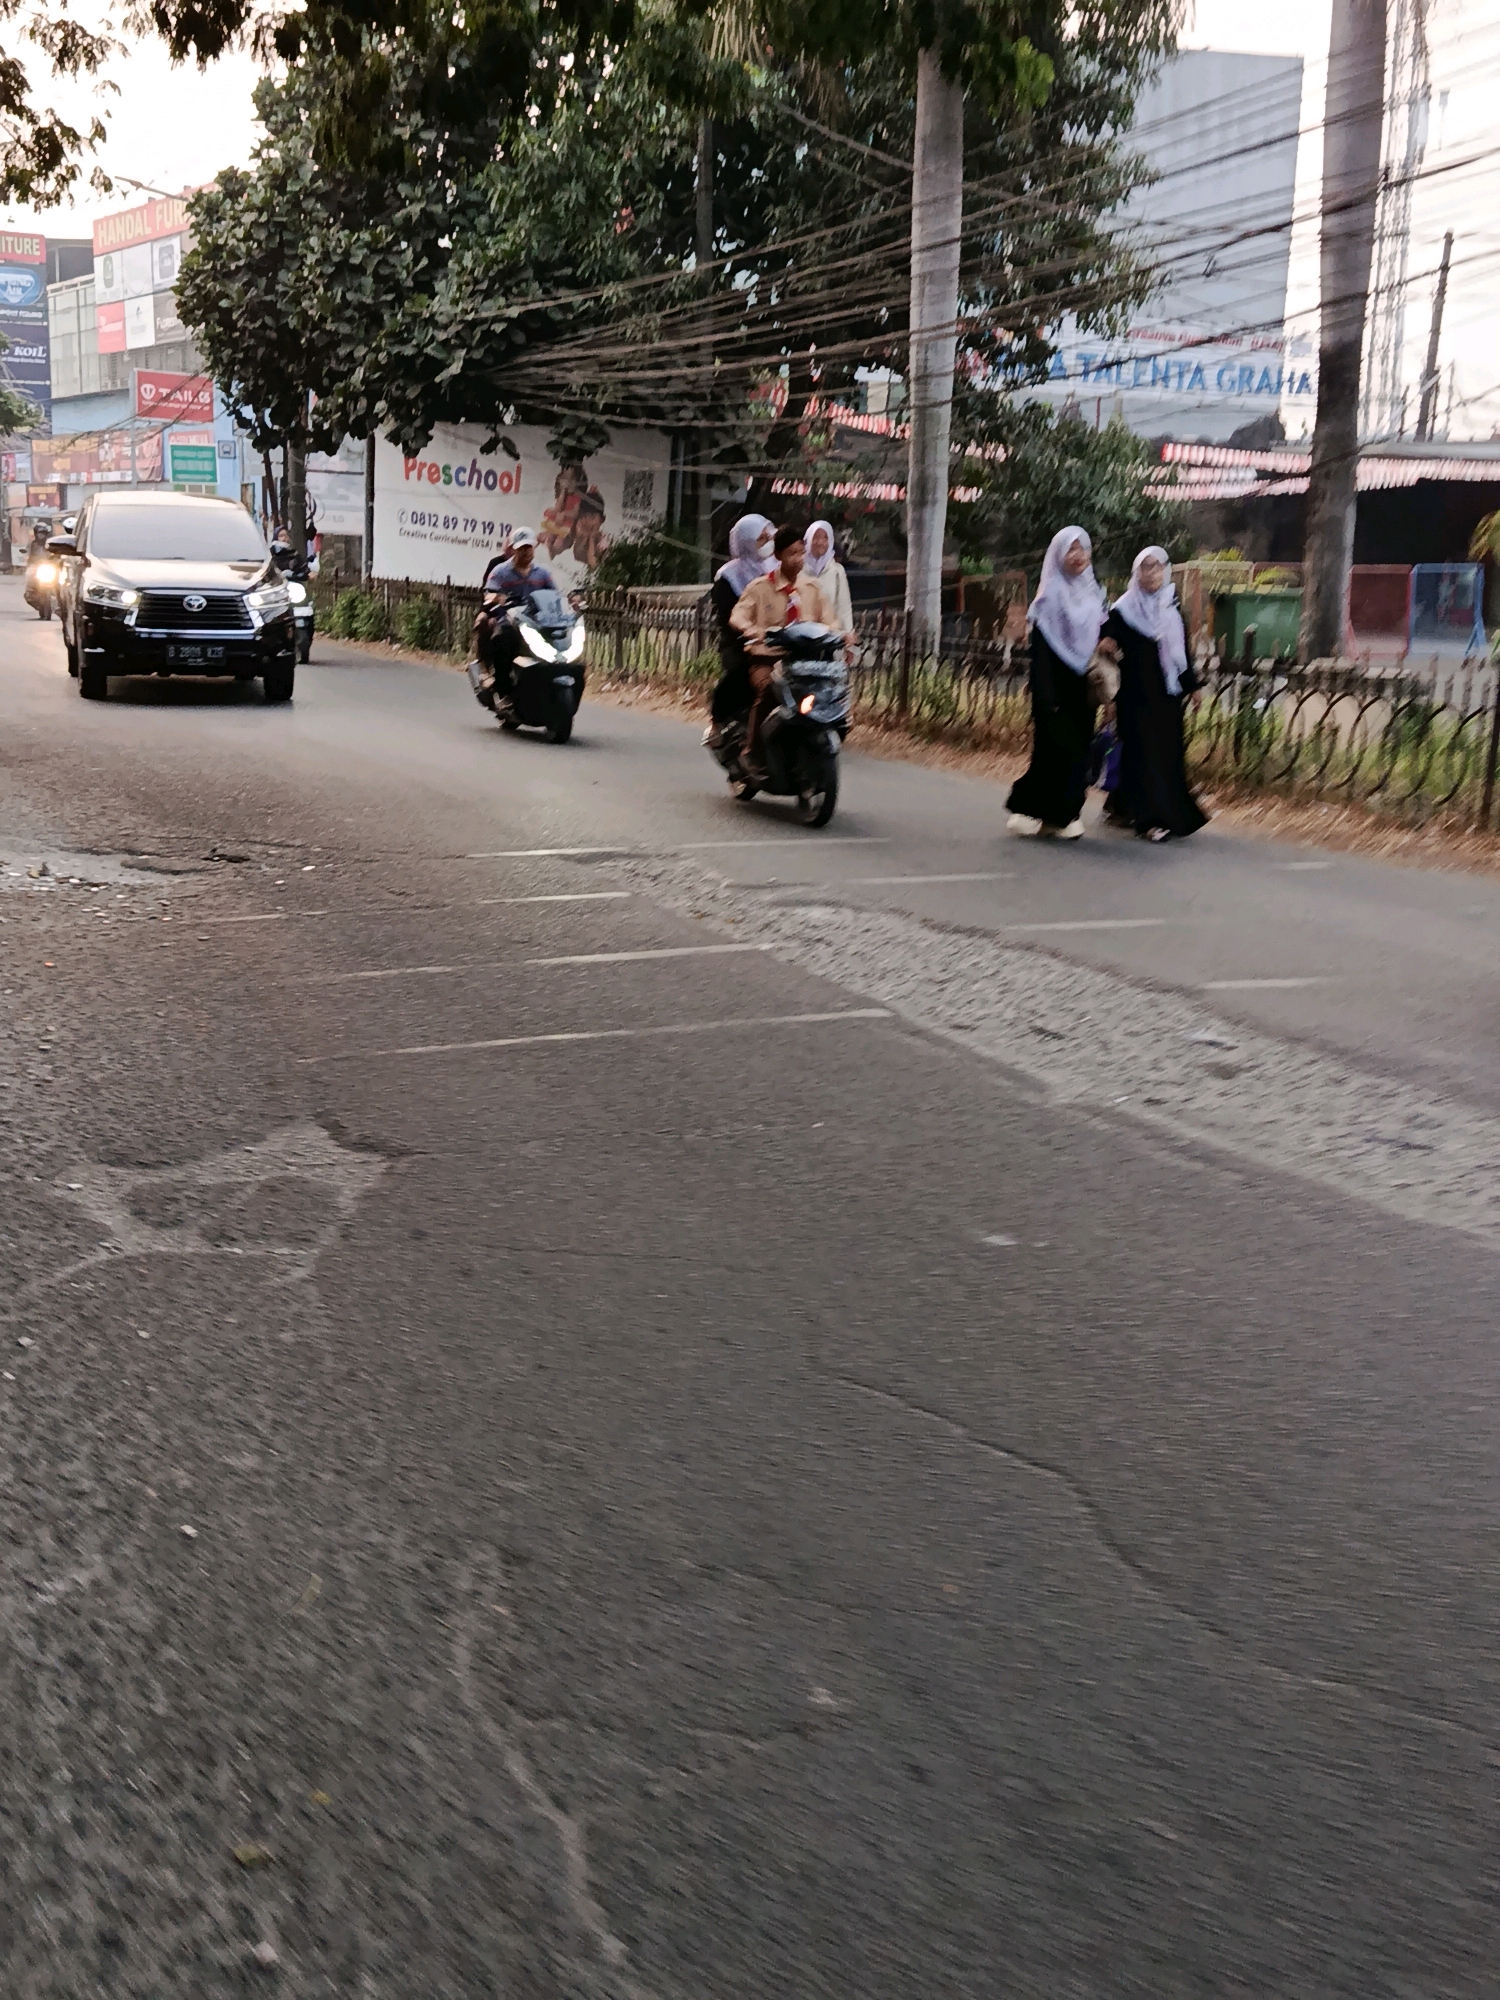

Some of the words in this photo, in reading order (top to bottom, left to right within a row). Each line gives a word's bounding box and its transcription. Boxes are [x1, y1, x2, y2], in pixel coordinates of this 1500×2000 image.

[97, 208, 152, 248] HANDAL
[404, 456, 523, 495] Preschool
[410, 511, 439, 528] 0812
[443, 515, 459, 531] 89
[463, 518, 477, 533] 79
[481, 520, 495, 536] 19
